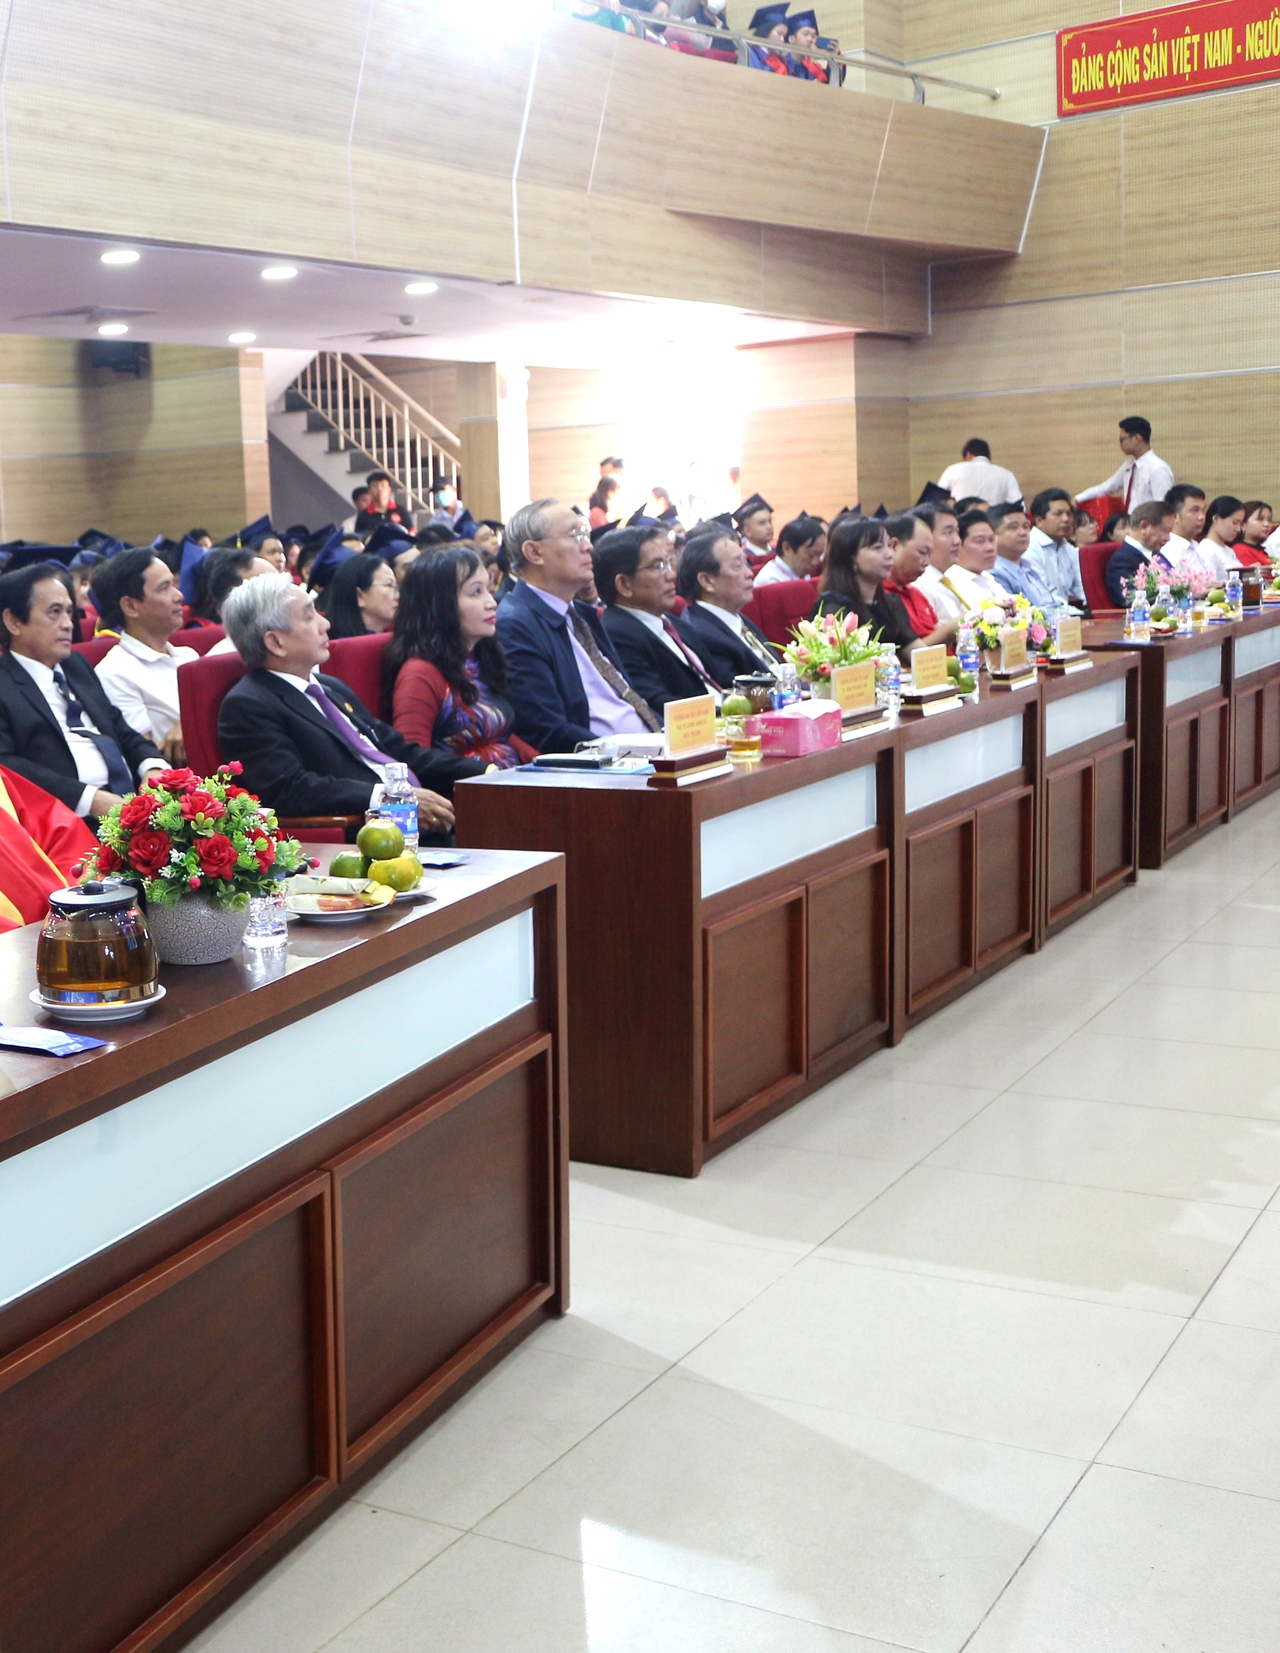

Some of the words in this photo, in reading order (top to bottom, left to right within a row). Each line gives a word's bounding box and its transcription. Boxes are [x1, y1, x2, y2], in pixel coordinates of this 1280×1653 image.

[1071, 42, 1105, 94] ĐẢNG
[1107, 39, 1140, 94] CỘNG
[1143, 27, 1168, 81] SẢN
[1171, 25, 1200, 81] VIỆT
[1204, 27, 1233, 69] NAM
